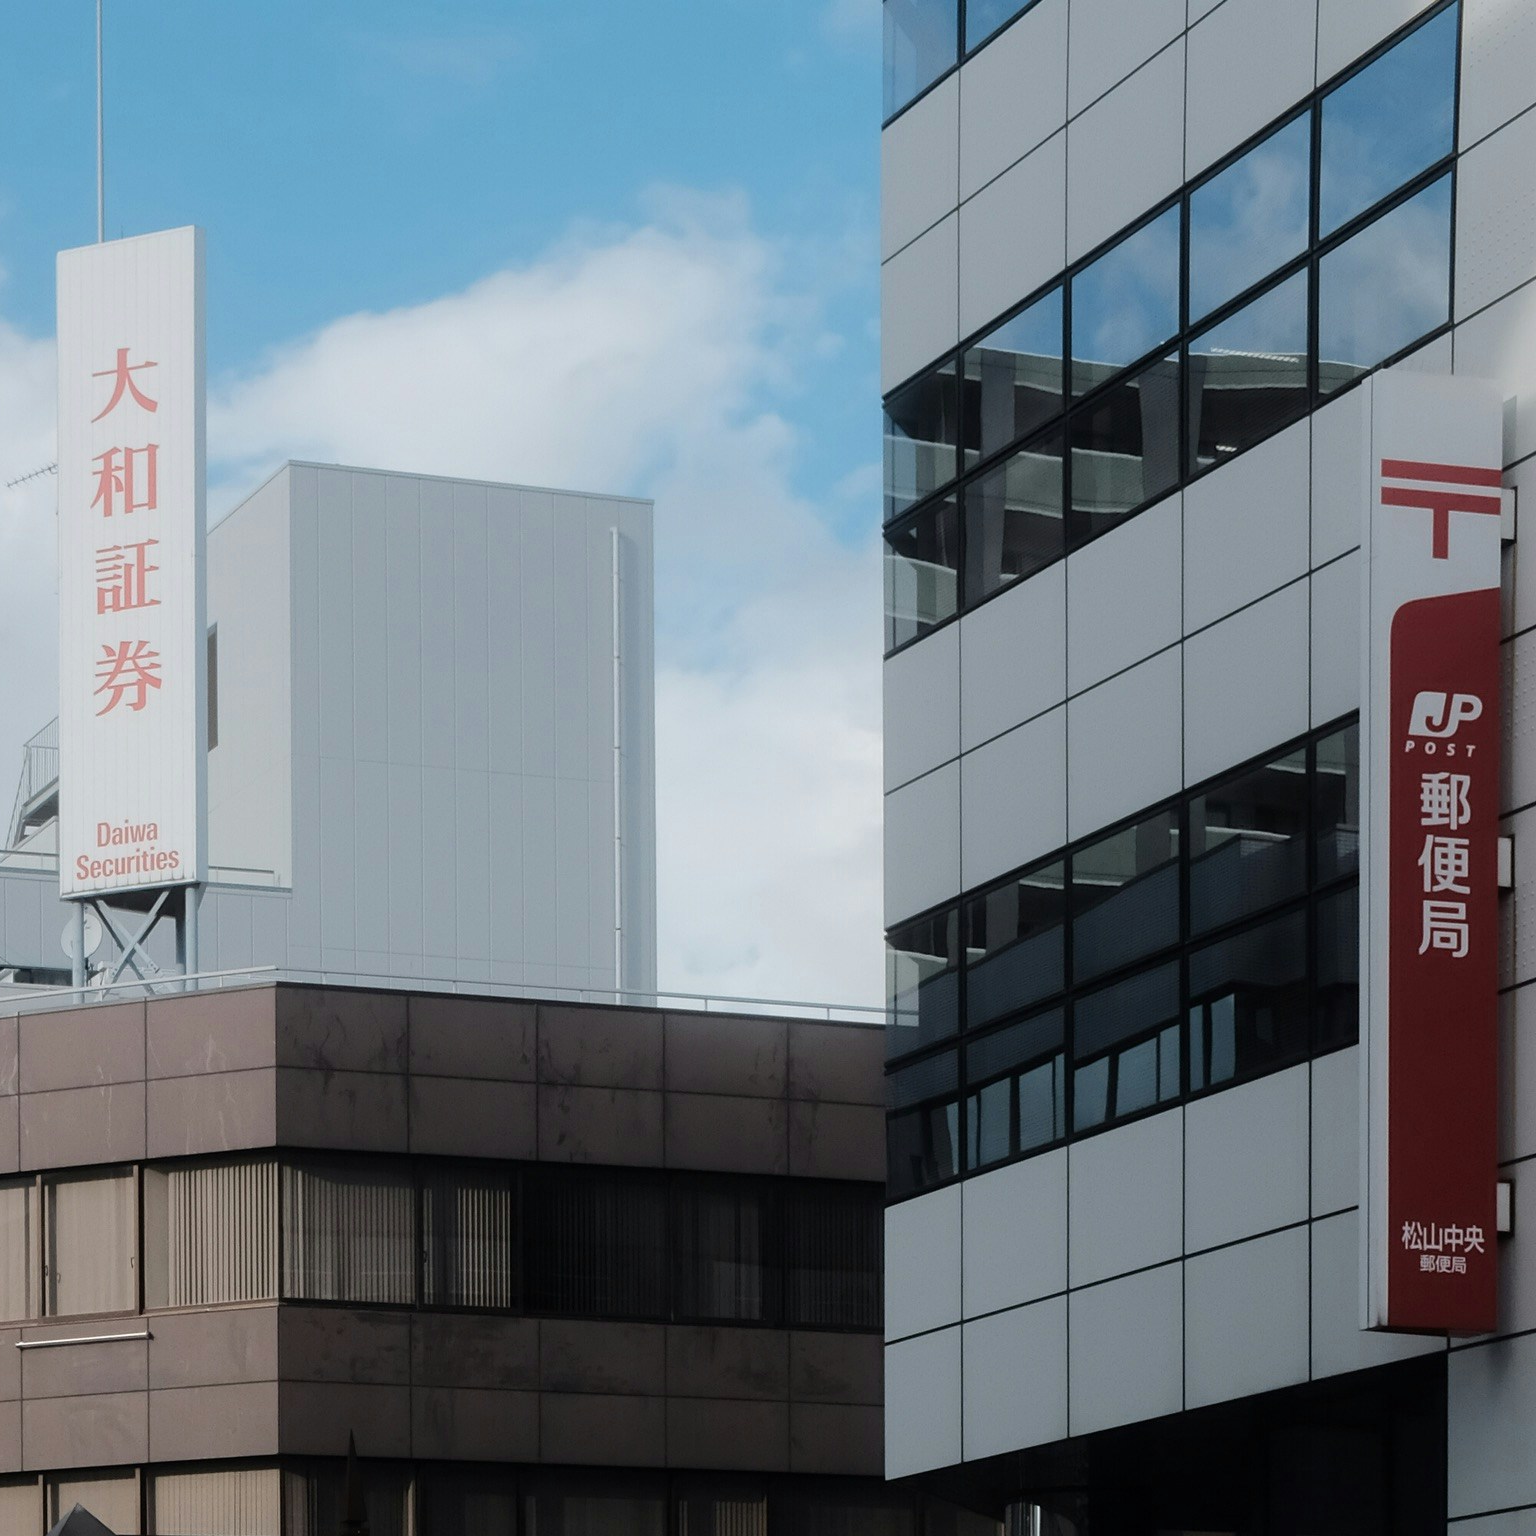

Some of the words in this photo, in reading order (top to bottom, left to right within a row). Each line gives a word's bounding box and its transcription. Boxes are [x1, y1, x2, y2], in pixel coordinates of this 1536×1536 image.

[90, 347, 162, 717] 大和証券
[1405, 740, 1476, 757] POST
[97, 819, 158, 848] Daiwa
[76, 846, 180, 880] Securities
[1417, 772, 1471, 958] 郵便局
[1402, 1221, 1485, 1253] 松山中央
[1420, 1254, 1467, 1274] 郵便局
